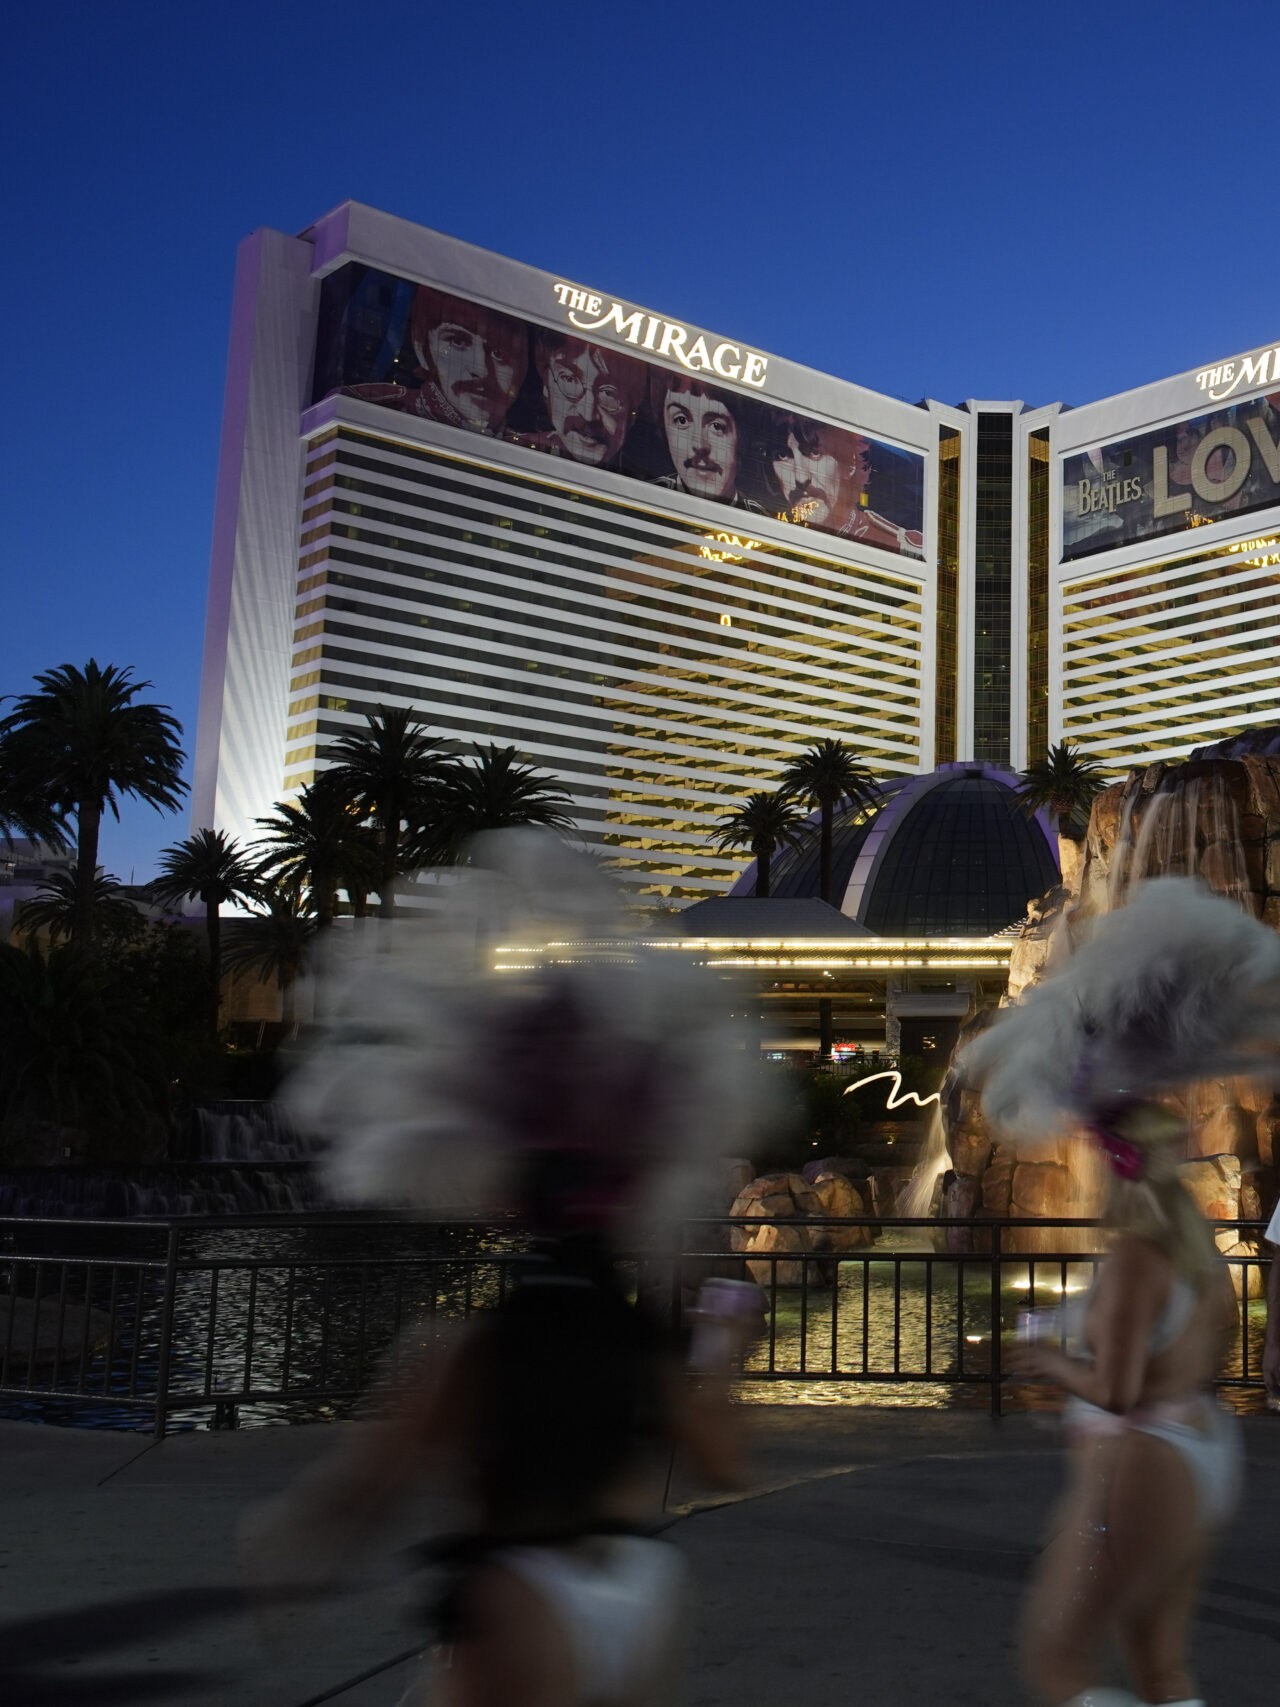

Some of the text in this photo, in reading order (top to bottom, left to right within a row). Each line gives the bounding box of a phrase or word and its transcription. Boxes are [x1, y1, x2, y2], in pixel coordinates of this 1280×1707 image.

[554, 283, 769, 388] THE MIRAGE
[1195, 362, 1235, 391] THE
[1103, 468, 1117, 482] THE
[1077, 476, 1143, 517] BEATLES
